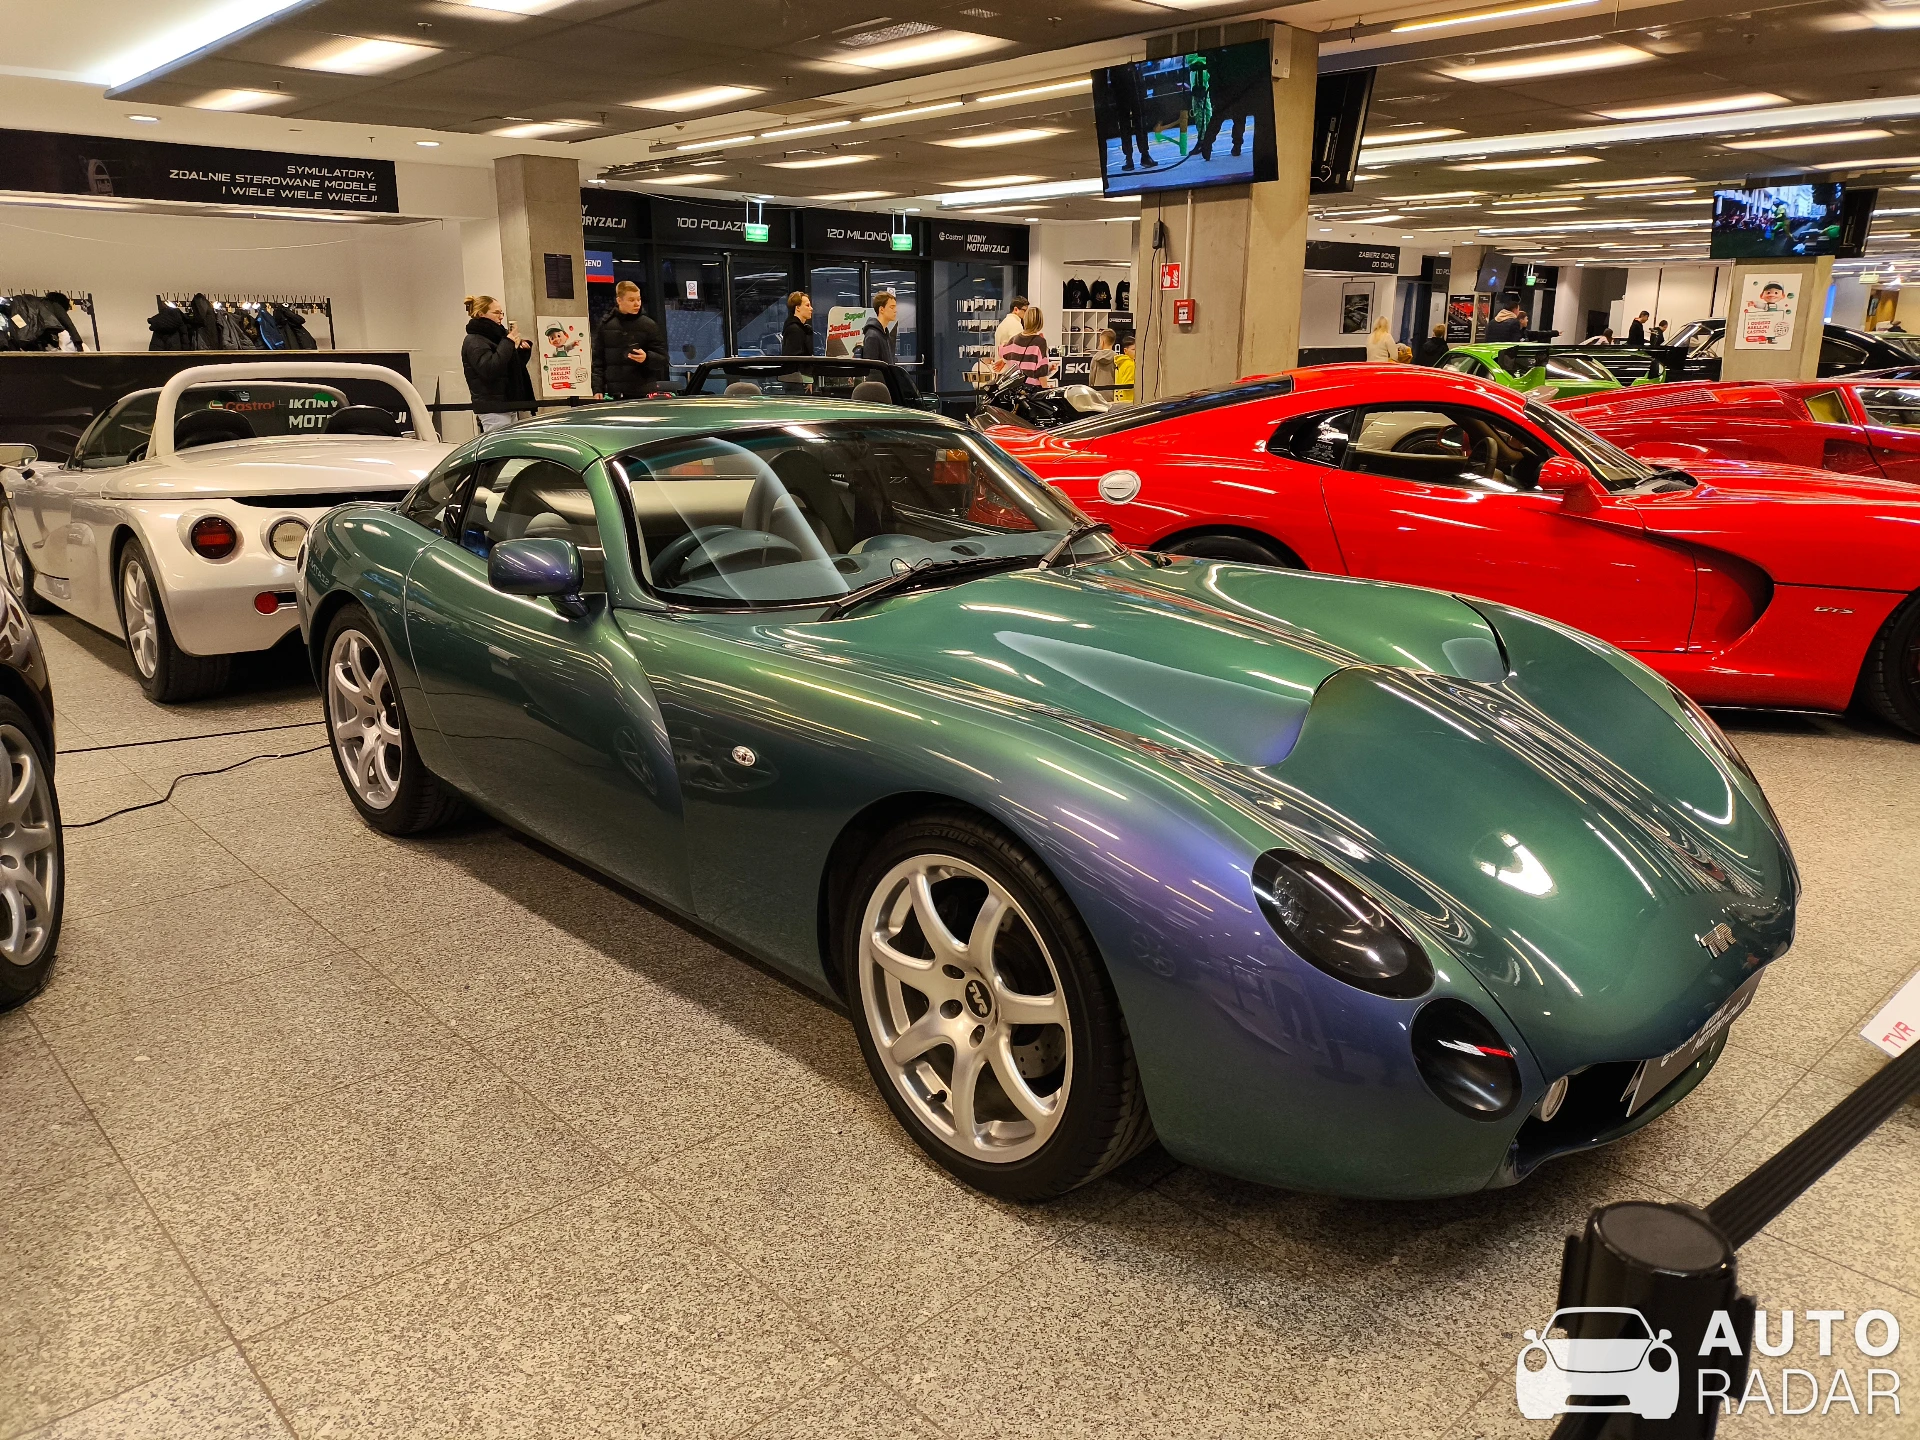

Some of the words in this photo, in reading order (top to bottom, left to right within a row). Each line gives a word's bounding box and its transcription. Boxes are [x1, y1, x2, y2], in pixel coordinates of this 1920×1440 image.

[287, 165, 375, 180] SYMULATORY,
[169, 169, 231, 182] ZDALNIE
[235, 174, 320, 188] STEROWANE
[324, 180, 377, 191] MODELE
[222, 185, 226, 195] I
[231, 186, 275, 197] WIELE
[280, 189, 323, 200] WIELE
[327, 192, 378, 203] WIĘCEJ!
[581, 215, 627, 229] ORYZACJI
[676, 217, 698, 229] 100
[826, 228, 844, 239] 120
[846, 229, 892, 242] MILIONÓ
[945, 233, 964, 241] Castrol
[967, 234, 987, 243] IKONY
[966, 243, 1010, 254] MOTORYZACJI
[584, 259, 602, 268] GEND
[1064, 362, 1091, 374] SKL
[225, 400, 275, 412] Castrol
[1813, 606, 1856, 614] GTS
[968, 981, 988, 1016] TVR
[1882, 1021, 1916, 1049] TVR
